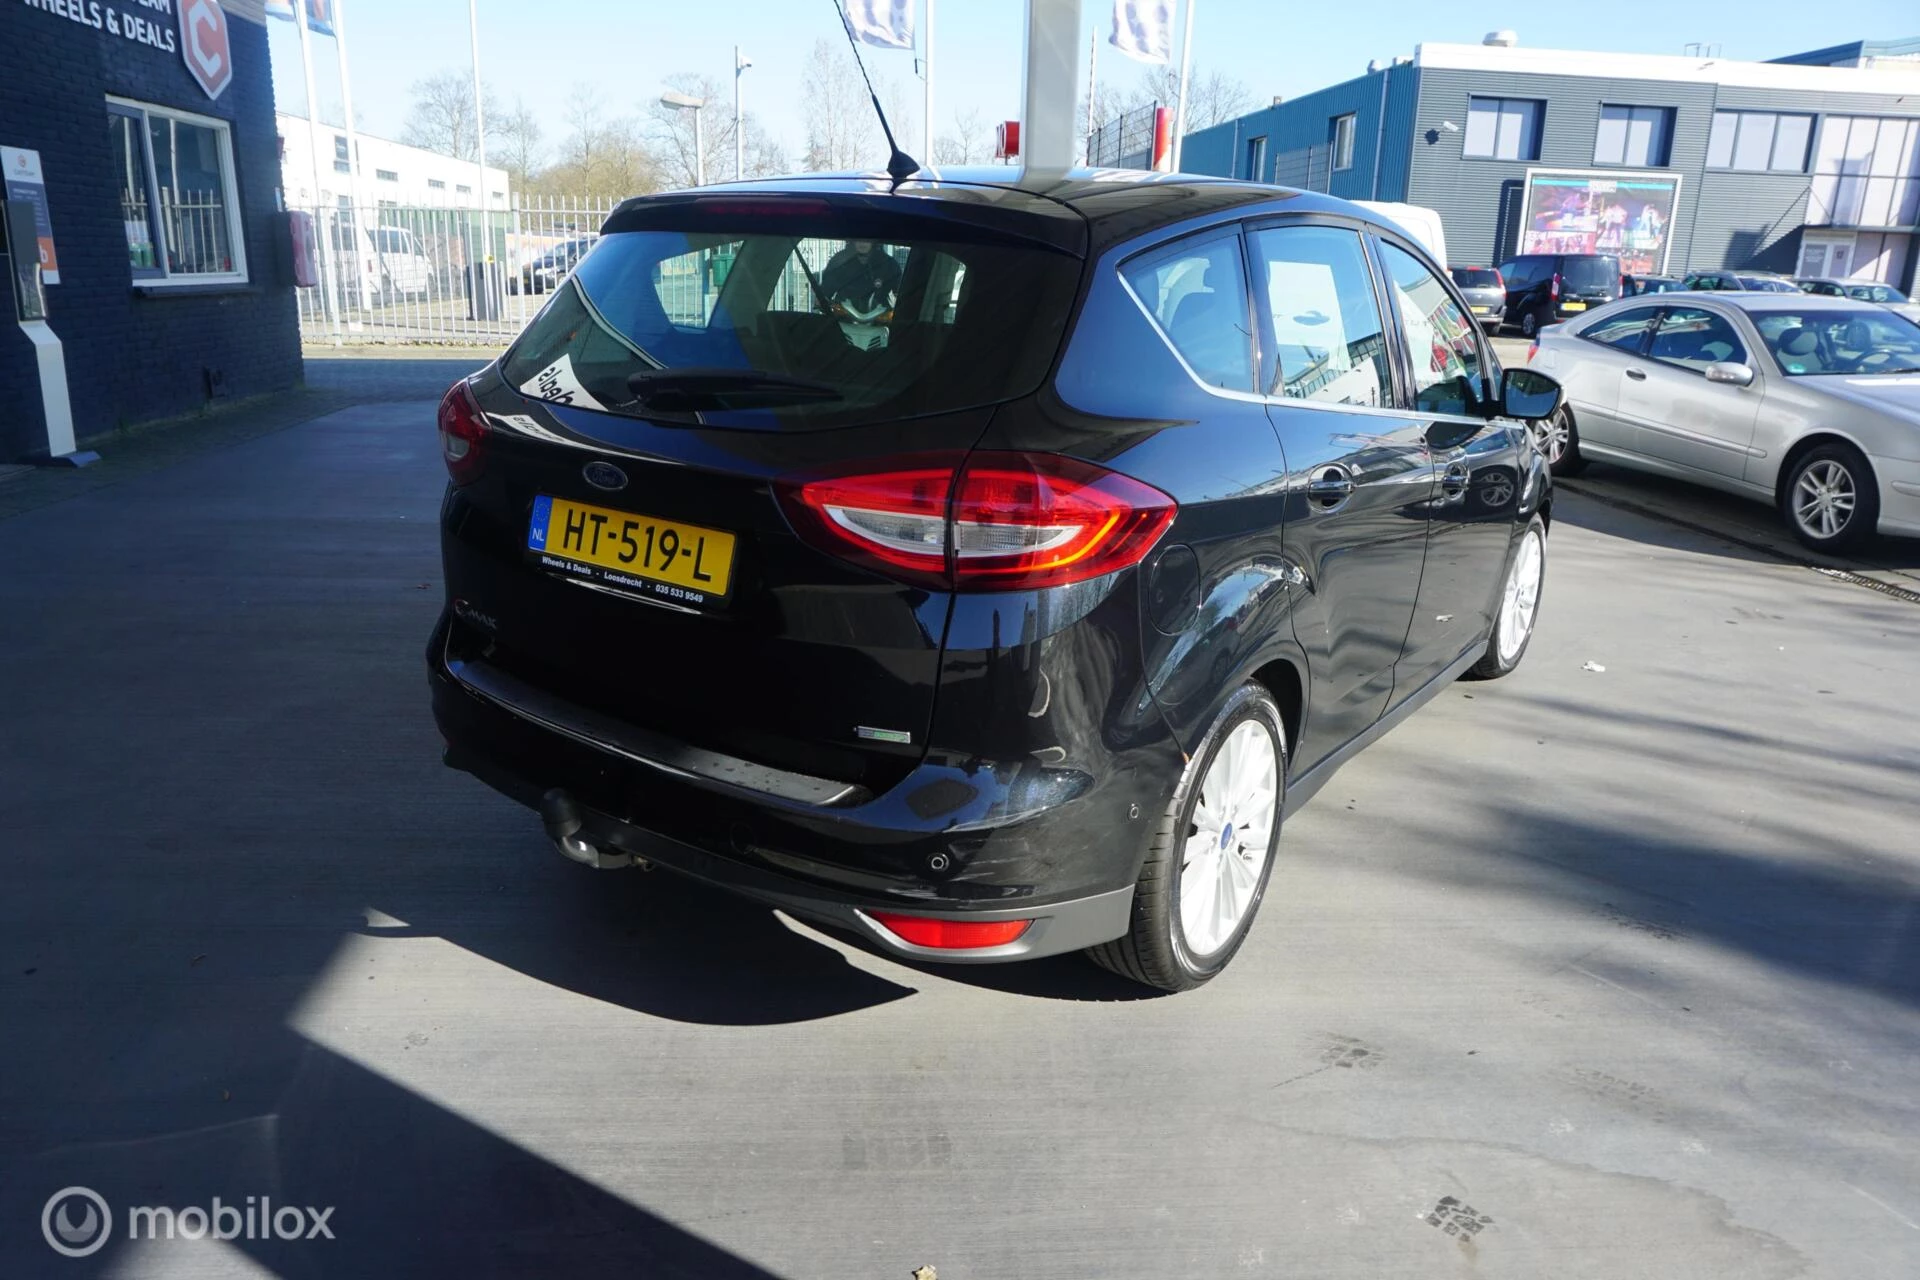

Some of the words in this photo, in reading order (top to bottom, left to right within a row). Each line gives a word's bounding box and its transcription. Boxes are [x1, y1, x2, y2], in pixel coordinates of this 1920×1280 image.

[106, 8, 120, 35] &
[123, 13, 176, 53] DEALS
[532, 527, 545, 542] NL
[563, 508, 711, 582] HT-519-L
[542, 556, 565, 569] Wheels
[573, 564, 592, 575] Deals
[604, 571, 643, 588] Loosdrecht
[655, 584, 669, 594] 035
[670, 588, 684, 598] 533
